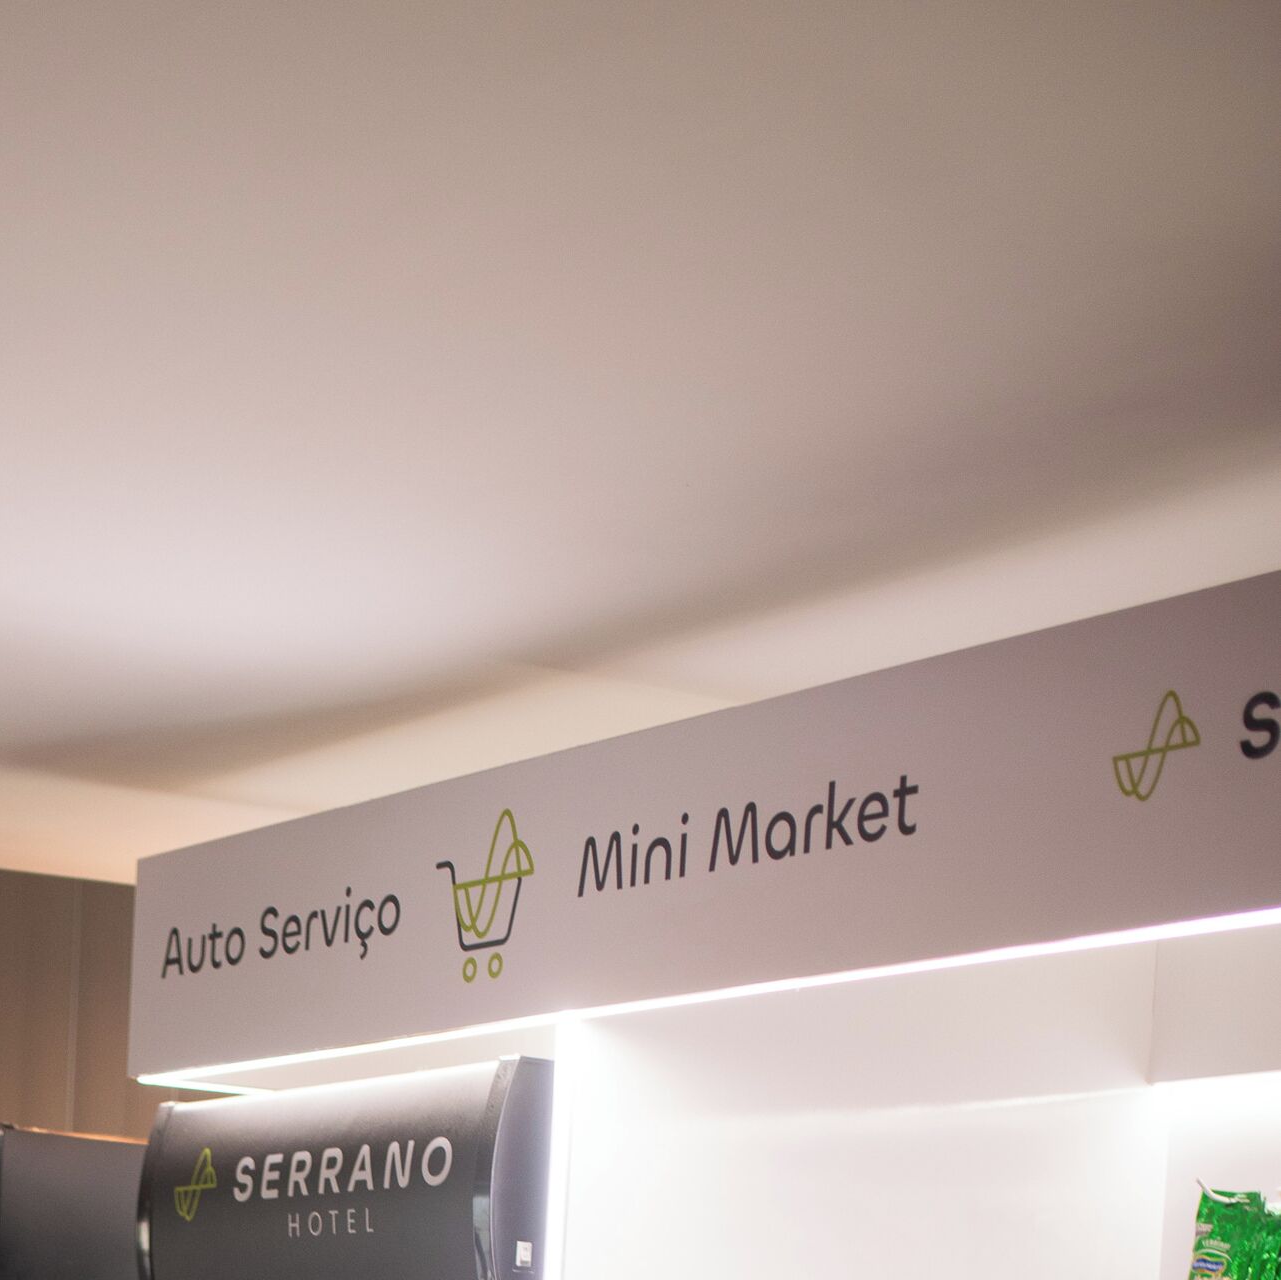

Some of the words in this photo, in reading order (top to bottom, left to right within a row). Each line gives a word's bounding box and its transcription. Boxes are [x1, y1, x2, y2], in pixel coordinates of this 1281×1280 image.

[577, 812, 690, 898] Mini
[708, 774, 919, 873] Market
[161, 926, 246, 979] Auto
[259, 886, 401, 960] Serviço
[233, 1136, 453, 1202] SERRANO
[287, 1207, 374, 1238] HOTEL
